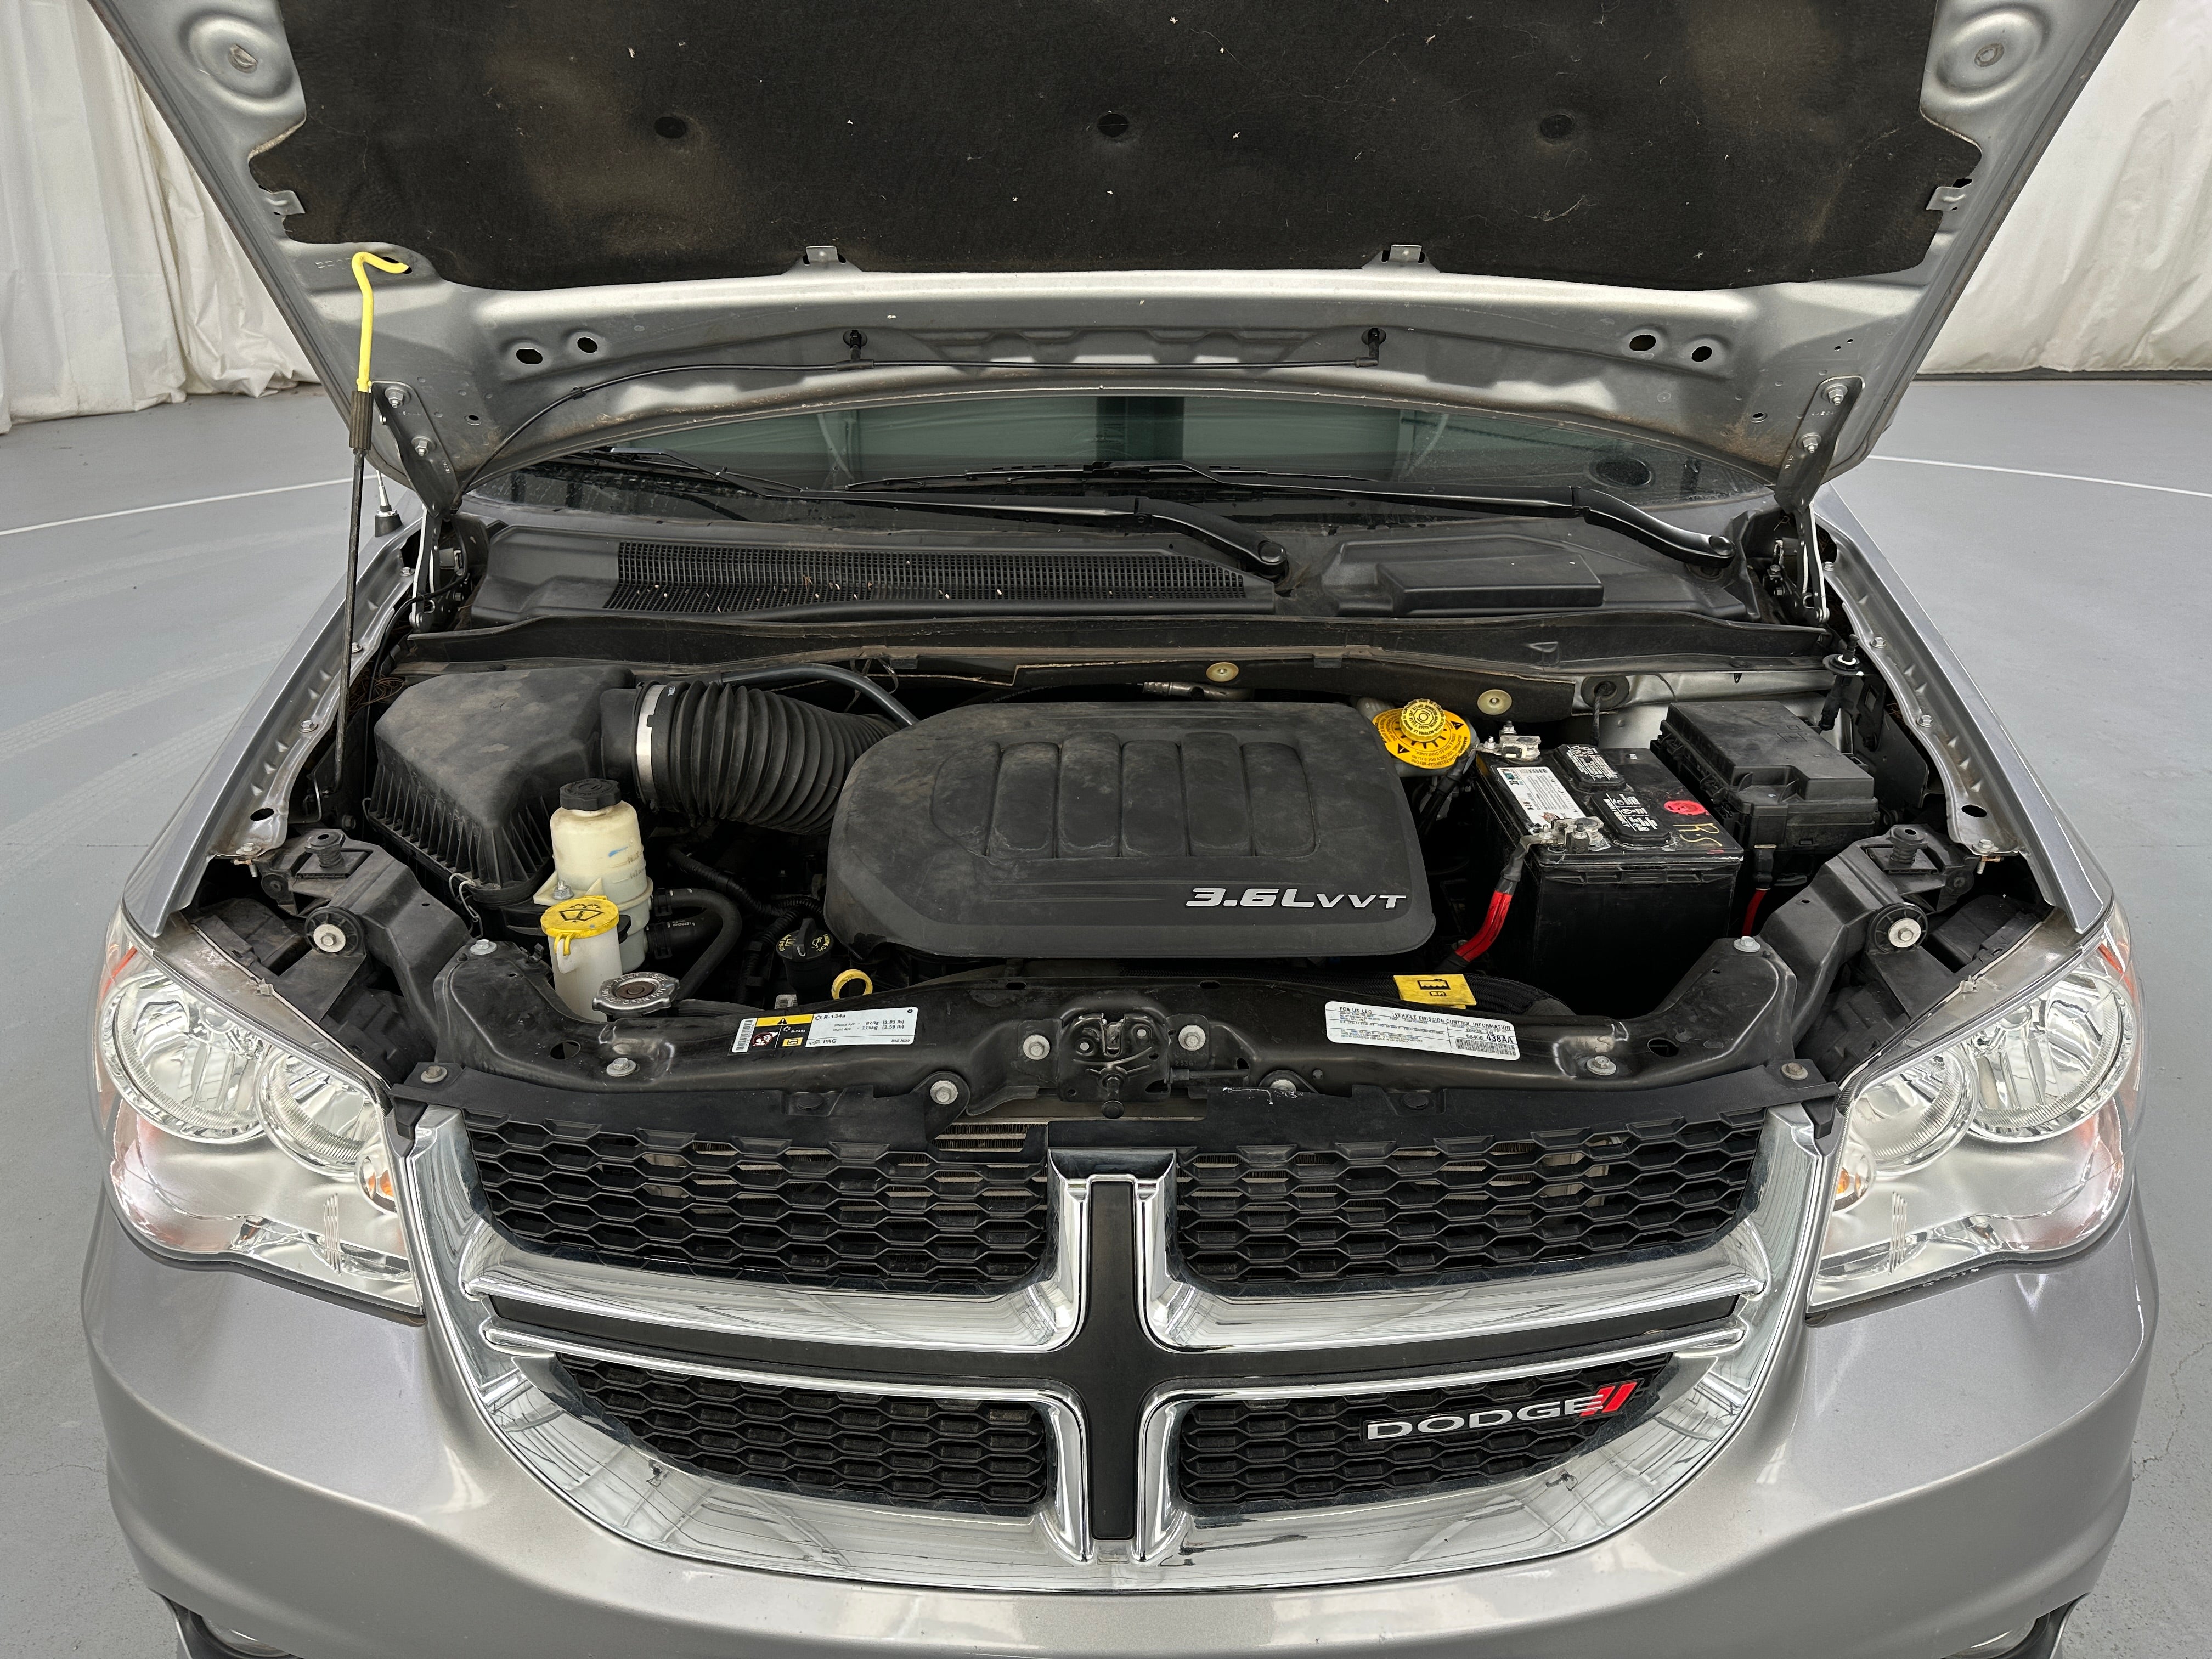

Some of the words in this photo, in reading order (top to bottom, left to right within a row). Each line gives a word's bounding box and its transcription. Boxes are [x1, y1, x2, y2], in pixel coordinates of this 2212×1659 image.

[1317, 894, 1407, 909] VVT
[1473, 1022, 1511, 1030] INFORMATION
[1486, 1034, 1514, 1044] 438AA
[1367, 1393, 1604, 1440] DODGE
